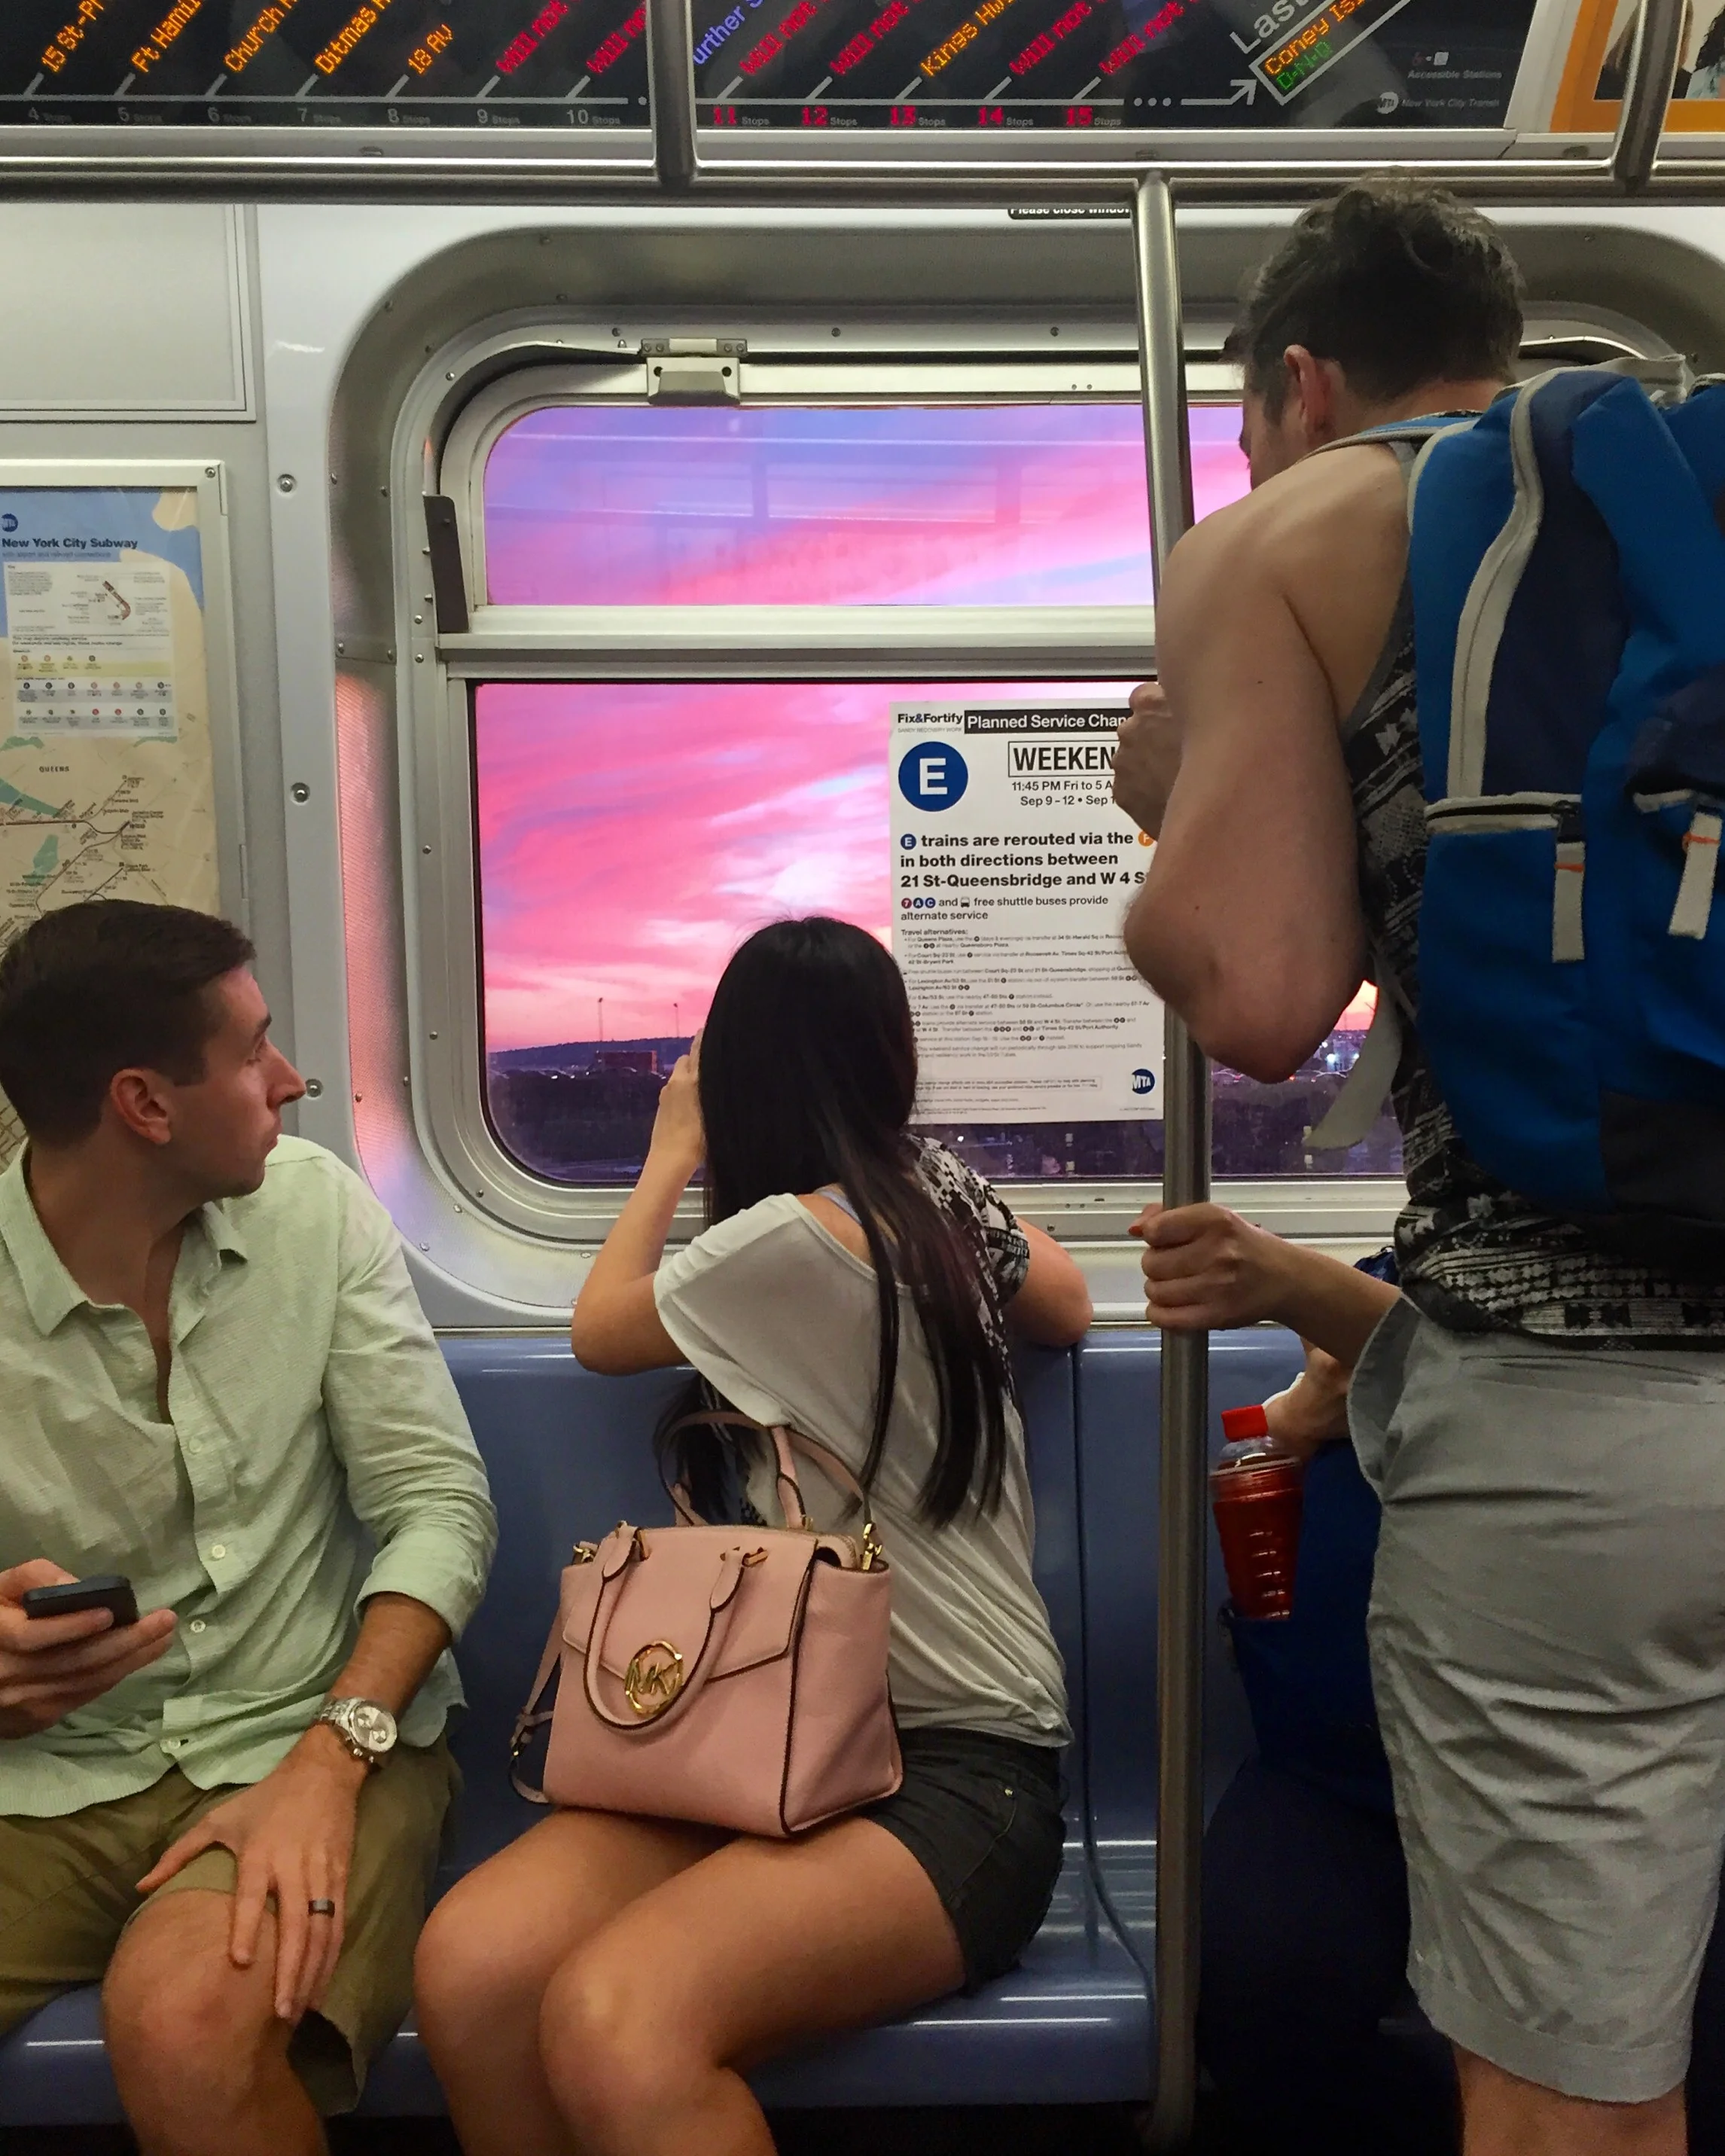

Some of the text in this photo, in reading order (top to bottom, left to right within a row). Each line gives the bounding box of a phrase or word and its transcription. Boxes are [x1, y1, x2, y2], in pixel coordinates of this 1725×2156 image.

[224, 6, 285, 72] Church
[314, 6, 376, 75] Ditmas
[692, 5, 746, 66] urther
[919, 0, 1013, 76] Kings Hw
[1264, 17, 1330, 75] Coney
[41, 44, 66, 73] 15
[130, 46, 160, 73] Ft
[407, 47, 433, 75] 18
[297, 108, 307, 122] 7
[387, 108, 399, 124] 8
[477, 108, 488, 124] 9
[567, 109, 589, 124] 10
[714, 106, 770, 127] 11 Stops
[802, 106, 858, 127] 12 Stops
[918, 117, 946, 127] Stops
[978, 106, 1034, 127] 14 Stops
[1066, 107, 1122, 127] 15 Stops
[2, 538, 138, 550] New York City Subway
[898, 713, 1130, 730] Fix&Fortify Planned Service Chan
[1013, 746, 1117, 771] WEEKEN
[919, 758, 948, 795] E
[1012, 782, 1039, 791] 11:45
[1042, 781, 1061, 791] PM
[1064, 780, 1078, 790] Fri
[1081, 781, 1093, 790] to
[1095, 780, 1102, 790] 5
[1020, 796, 1043, 807] Sep
[1045, 796, 1053, 806] 9
[1062, 795, 1074, 805] 12
[1086, 795, 1108, 807] Sep
[921, 834, 969, 847] trains
[973, 836, 1000, 846] are
[1004, 833, 1075, 846] rerouted
[1080, 832, 1103, 845] via
[1107, 832, 1134, 844] the
[901, 853, 1118, 868] in both directions between
[901, 871, 1146, 889] 21 St-Queensbridge and W 4 S
[939, 898, 958, 907] and
[974, 897, 995, 906] free
[998, 896, 1033, 906] shuttle
[1035, 897, 1067, 906] buses
[1069, 895, 1108, 907] provide
[901, 910, 988, 921] alternate service
